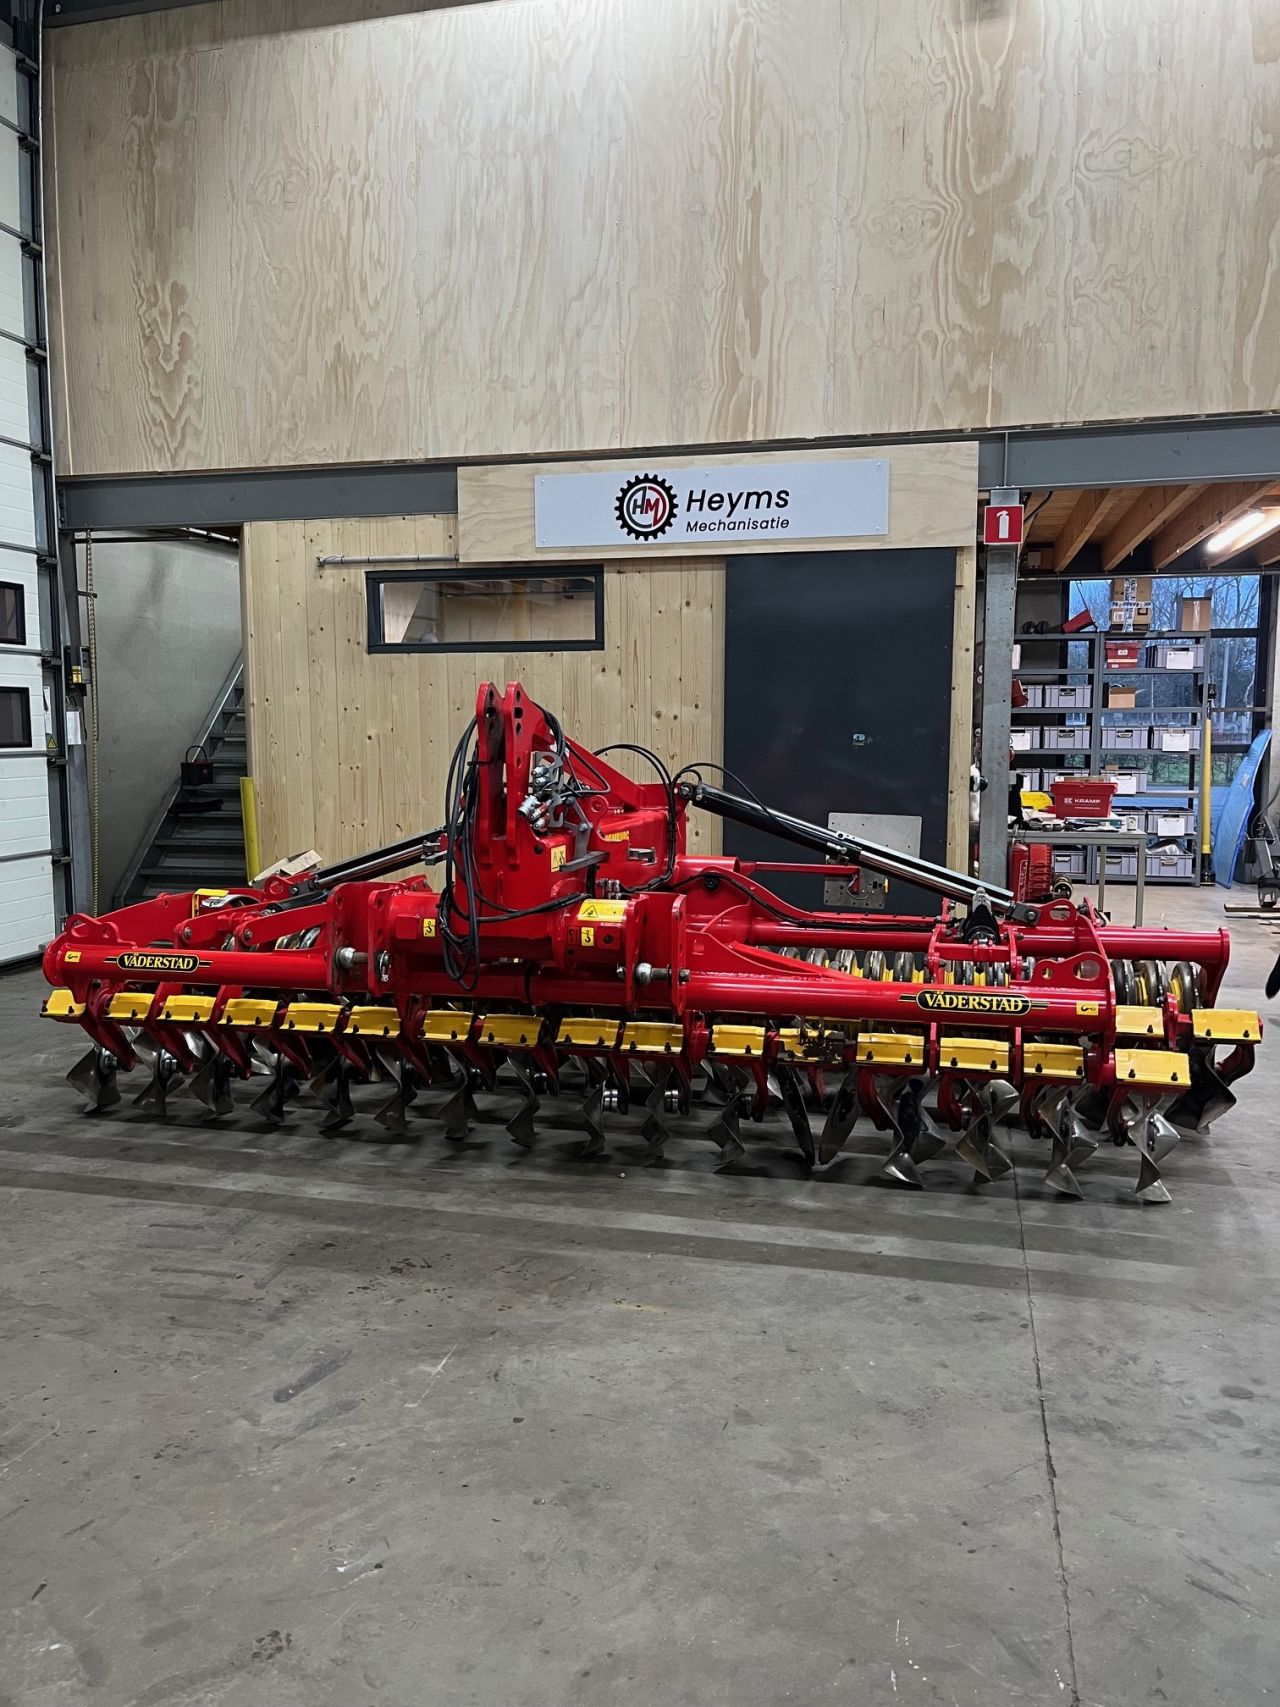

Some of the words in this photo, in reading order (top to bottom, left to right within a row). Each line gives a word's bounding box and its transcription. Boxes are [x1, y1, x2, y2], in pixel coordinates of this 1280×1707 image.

[686, 489, 790, 518] Heyms
[686, 516, 790, 532] Mechanisatie
[123, 953, 194, 970] VÄDERSTAD
[924, 991, 1023, 1012] VÄDERSTAD
